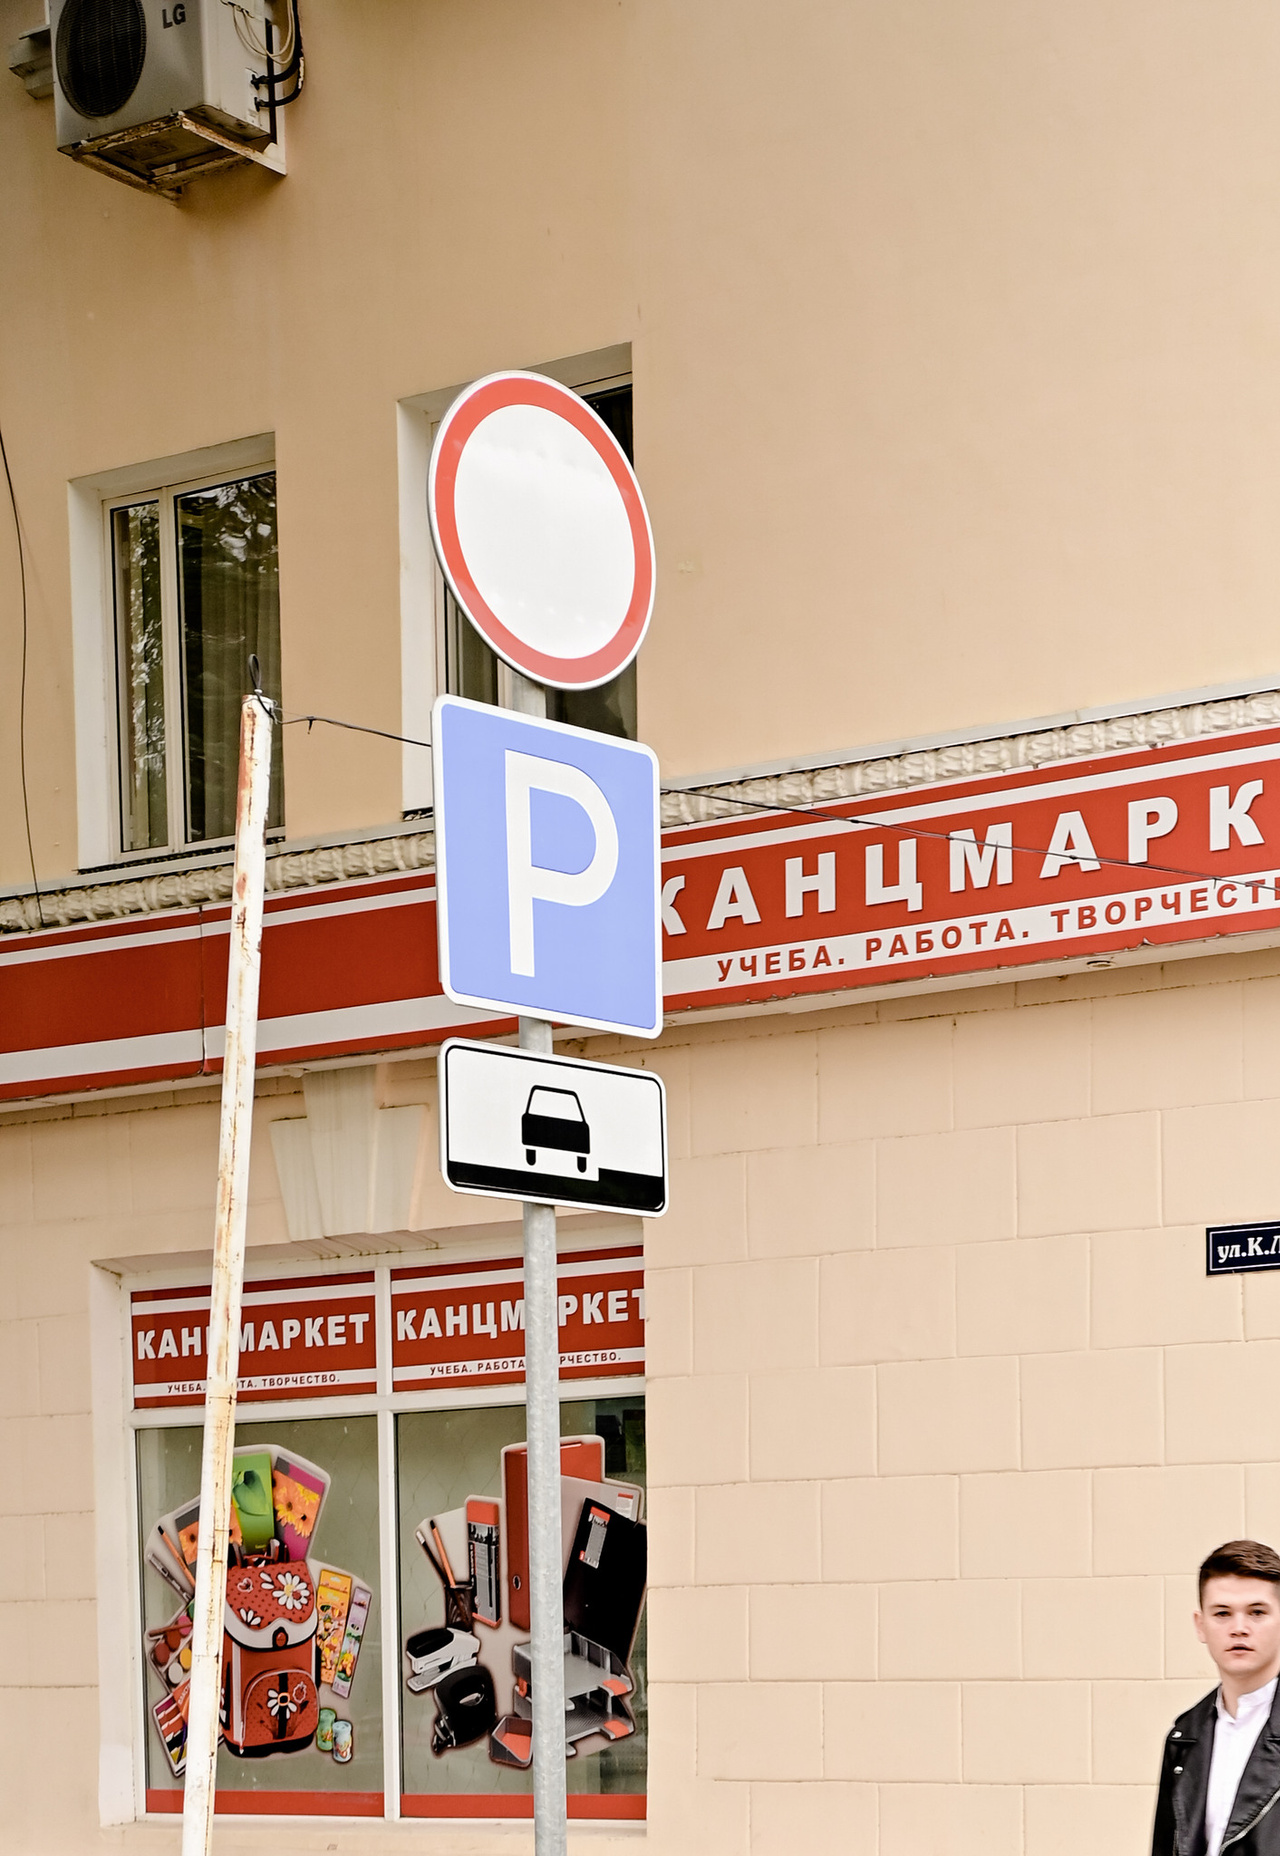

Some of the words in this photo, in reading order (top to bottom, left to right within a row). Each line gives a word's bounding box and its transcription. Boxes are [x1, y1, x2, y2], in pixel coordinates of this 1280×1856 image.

[162, 3, 186, 29] LG
[717, 946, 845, 982] УЧЕБА.
[865, 917, 1029, 961] РАБОТА.
[396, 1288, 645, 1341] КАНЦМРКЕТ
[137, 1313, 370, 1360] КАНМАРКЕТ
[430, 1364, 472, 1376] УЧЕБА.
[559, 1352, 622, 1365] РЧЕСТВО.
[167, 1383, 206, 1394] УЧЕБА.
[262, 1374, 340, 1387] ТВОРЧЕСТВО.
